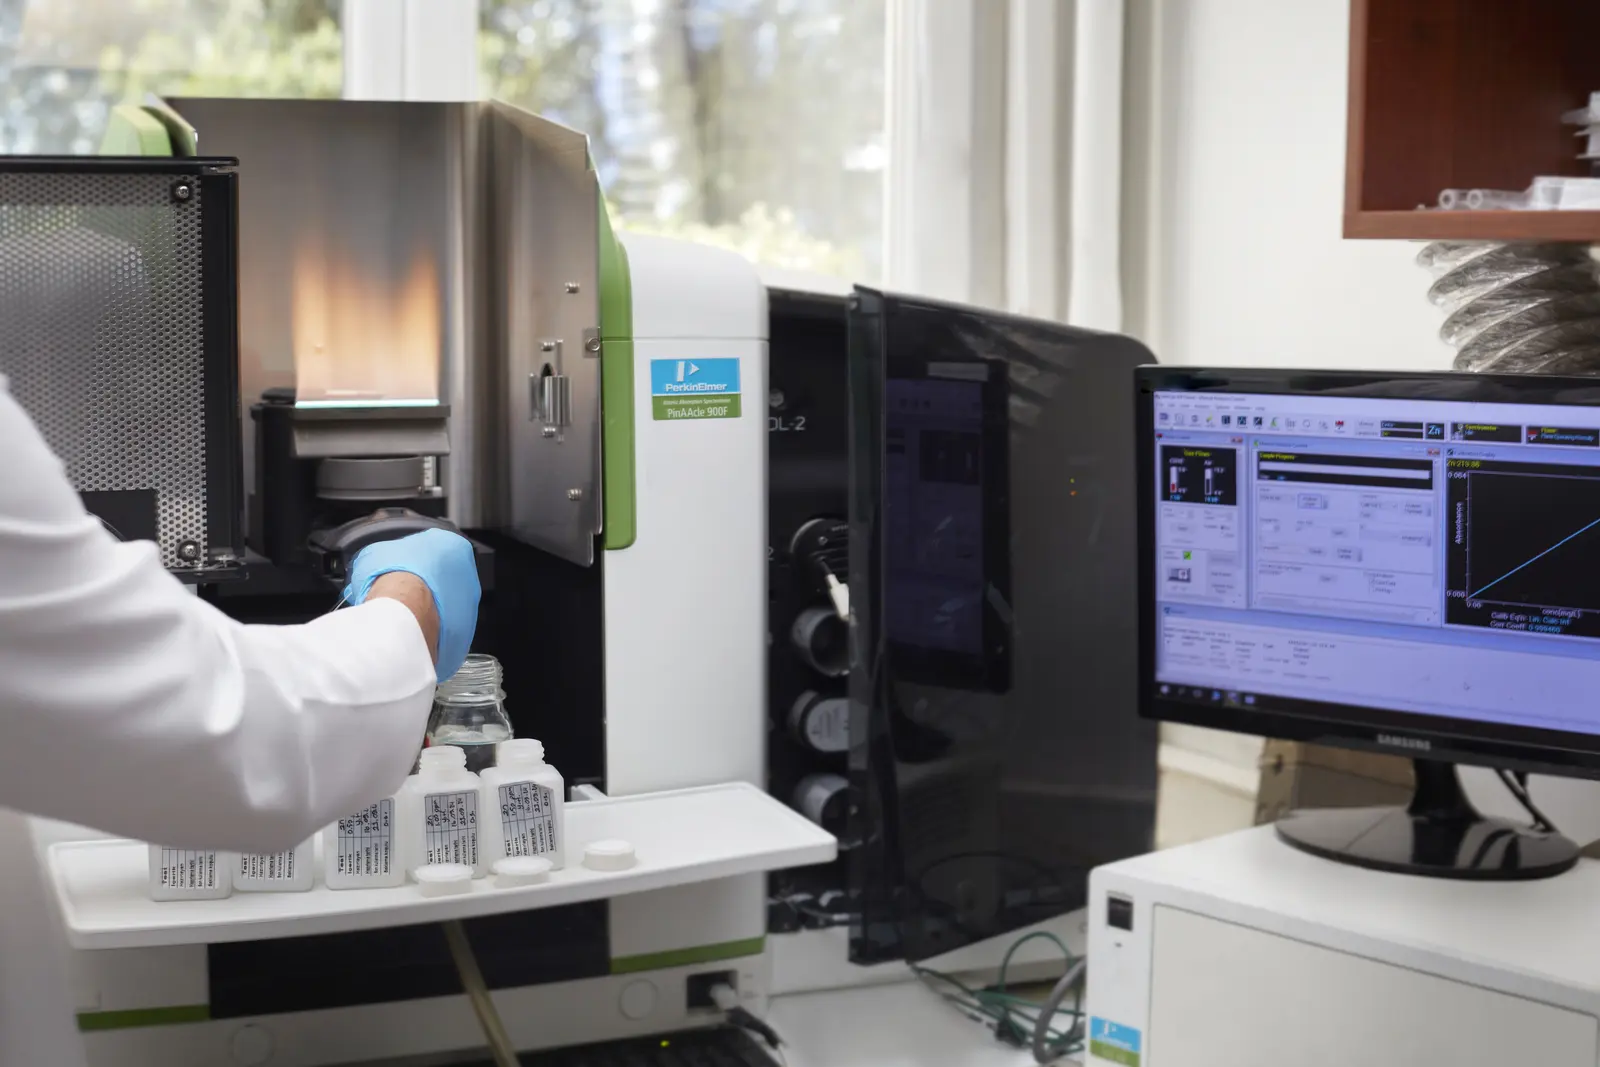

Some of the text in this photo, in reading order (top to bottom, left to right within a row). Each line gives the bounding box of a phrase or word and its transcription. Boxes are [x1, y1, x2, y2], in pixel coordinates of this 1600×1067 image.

[665, 383, 728, 392] PerkinElmer
[667, 406, 729, 418] PinAAcle 900F
[1428, 424, 1441, 436] Zn
[1455, 502, 1464, 544] Absorbance
[1447, 590, 1466, 598] 0.000
[1467, 601, 1482, 609] 0.00
[1377, 733, 1431, 751] SAMSUNG
